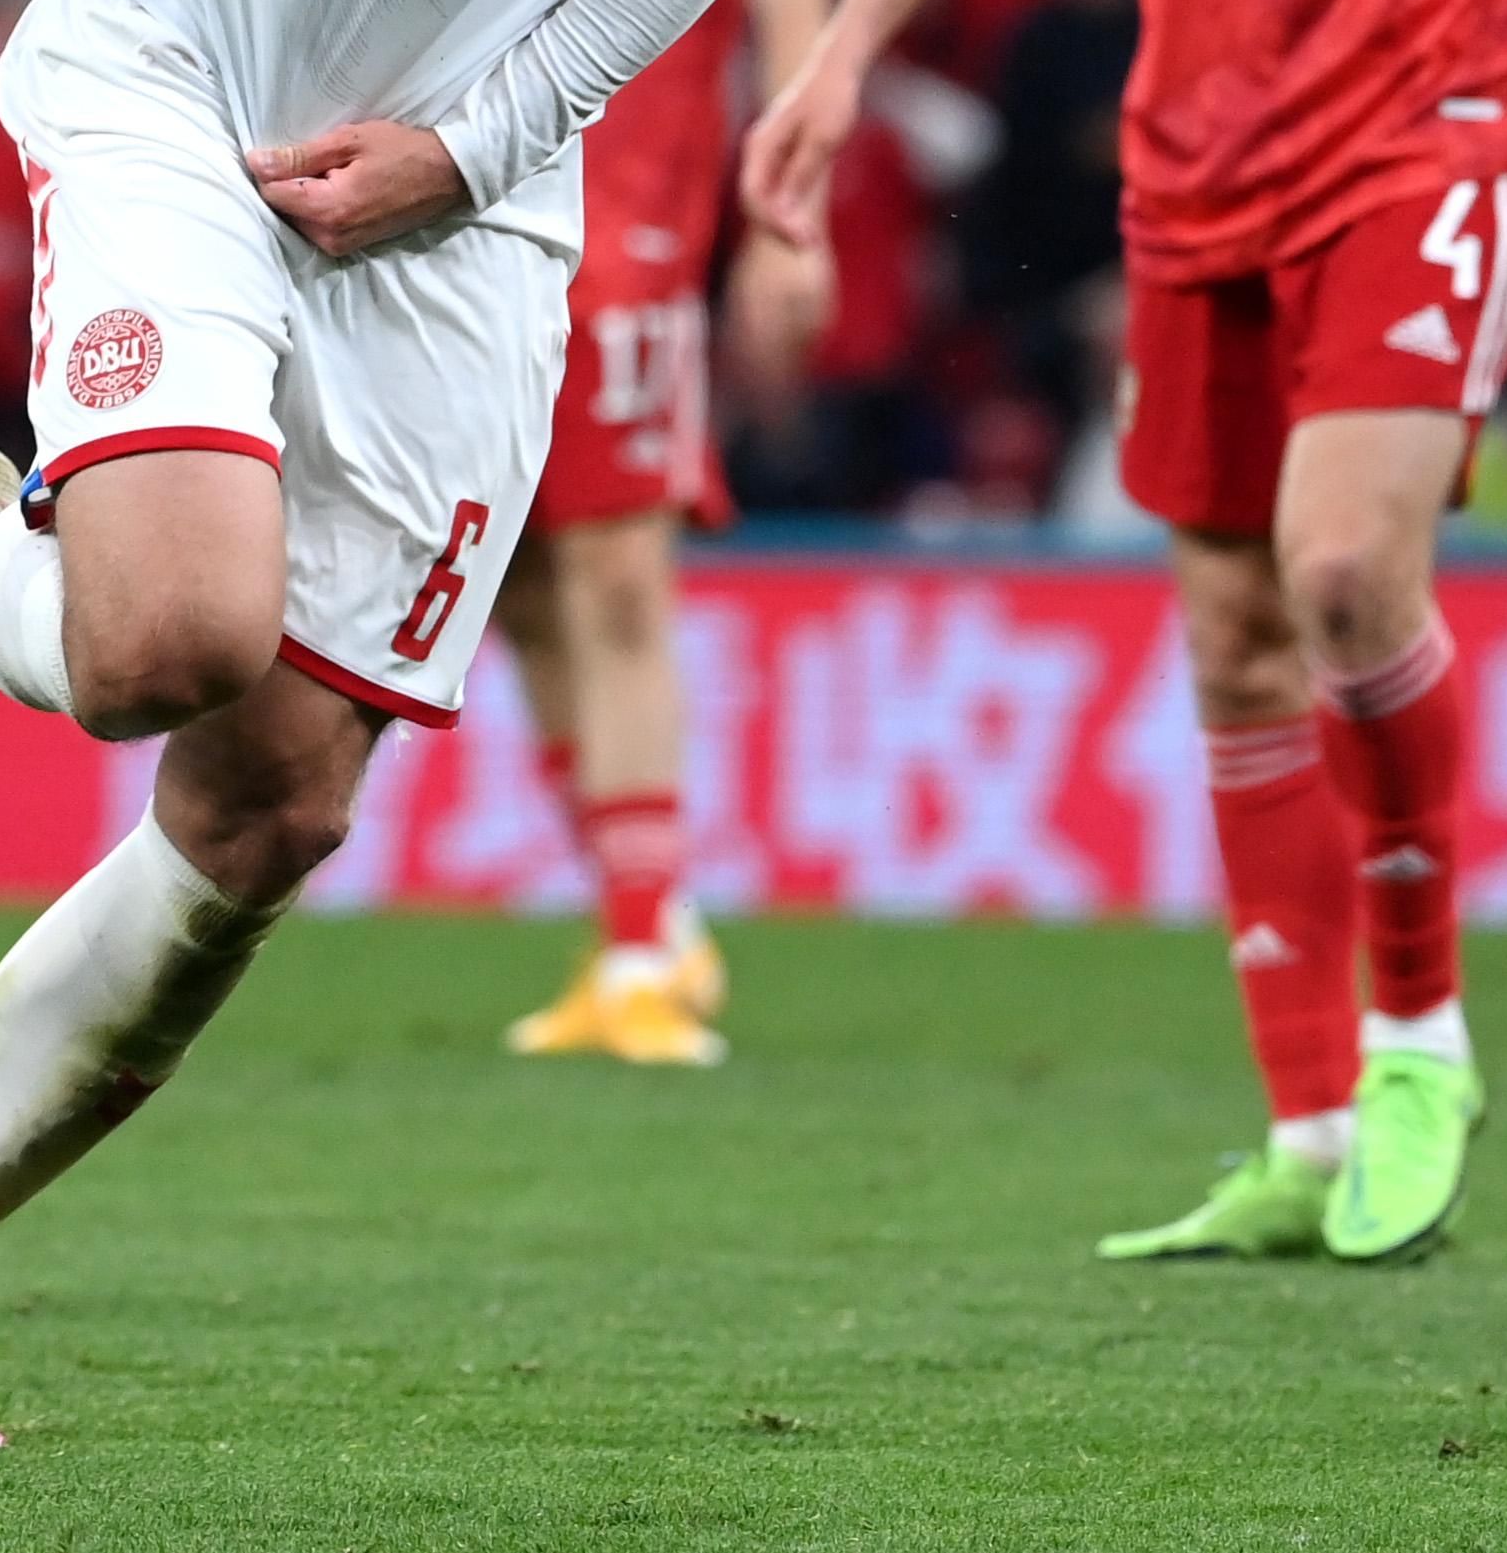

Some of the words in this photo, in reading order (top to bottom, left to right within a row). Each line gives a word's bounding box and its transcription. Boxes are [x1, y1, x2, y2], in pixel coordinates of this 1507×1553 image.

[1420, 178, 1484, 301] 4
[82, 336, 143, 380] DBU
[138, 329, 162, 387] UNION
[391, 498, 490, 663] 6
